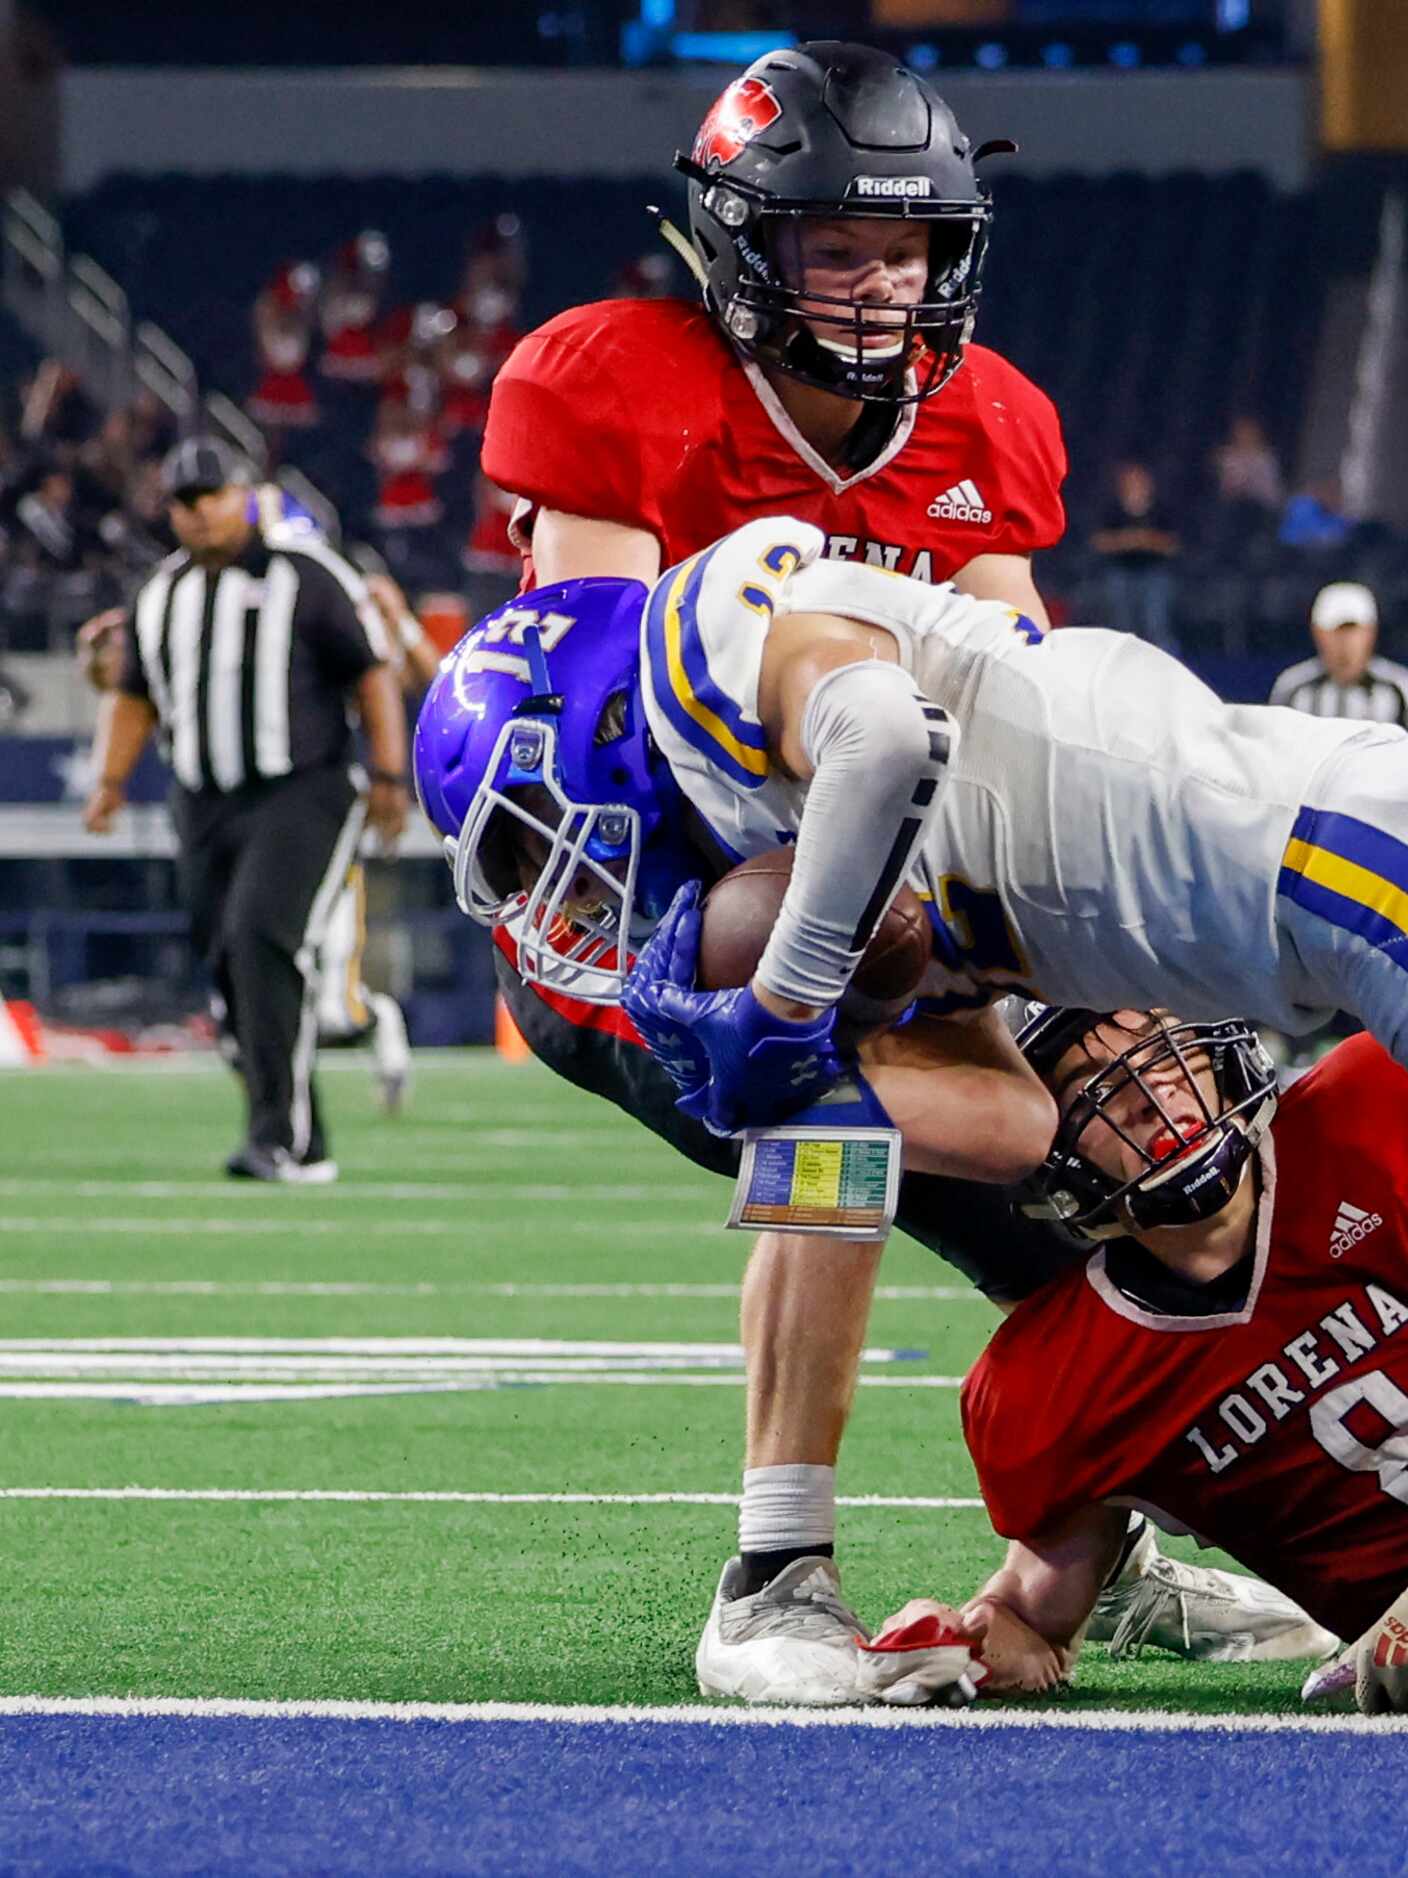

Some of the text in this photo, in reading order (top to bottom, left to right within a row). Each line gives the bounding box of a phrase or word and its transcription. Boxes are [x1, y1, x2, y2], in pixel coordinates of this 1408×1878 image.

[857, 177, 931, 197] Riddell
[927, 503, 992, 524] adidas
[828, 536, 932, 584] ENA
[1329, 1212, 1383, 1258] adidas
